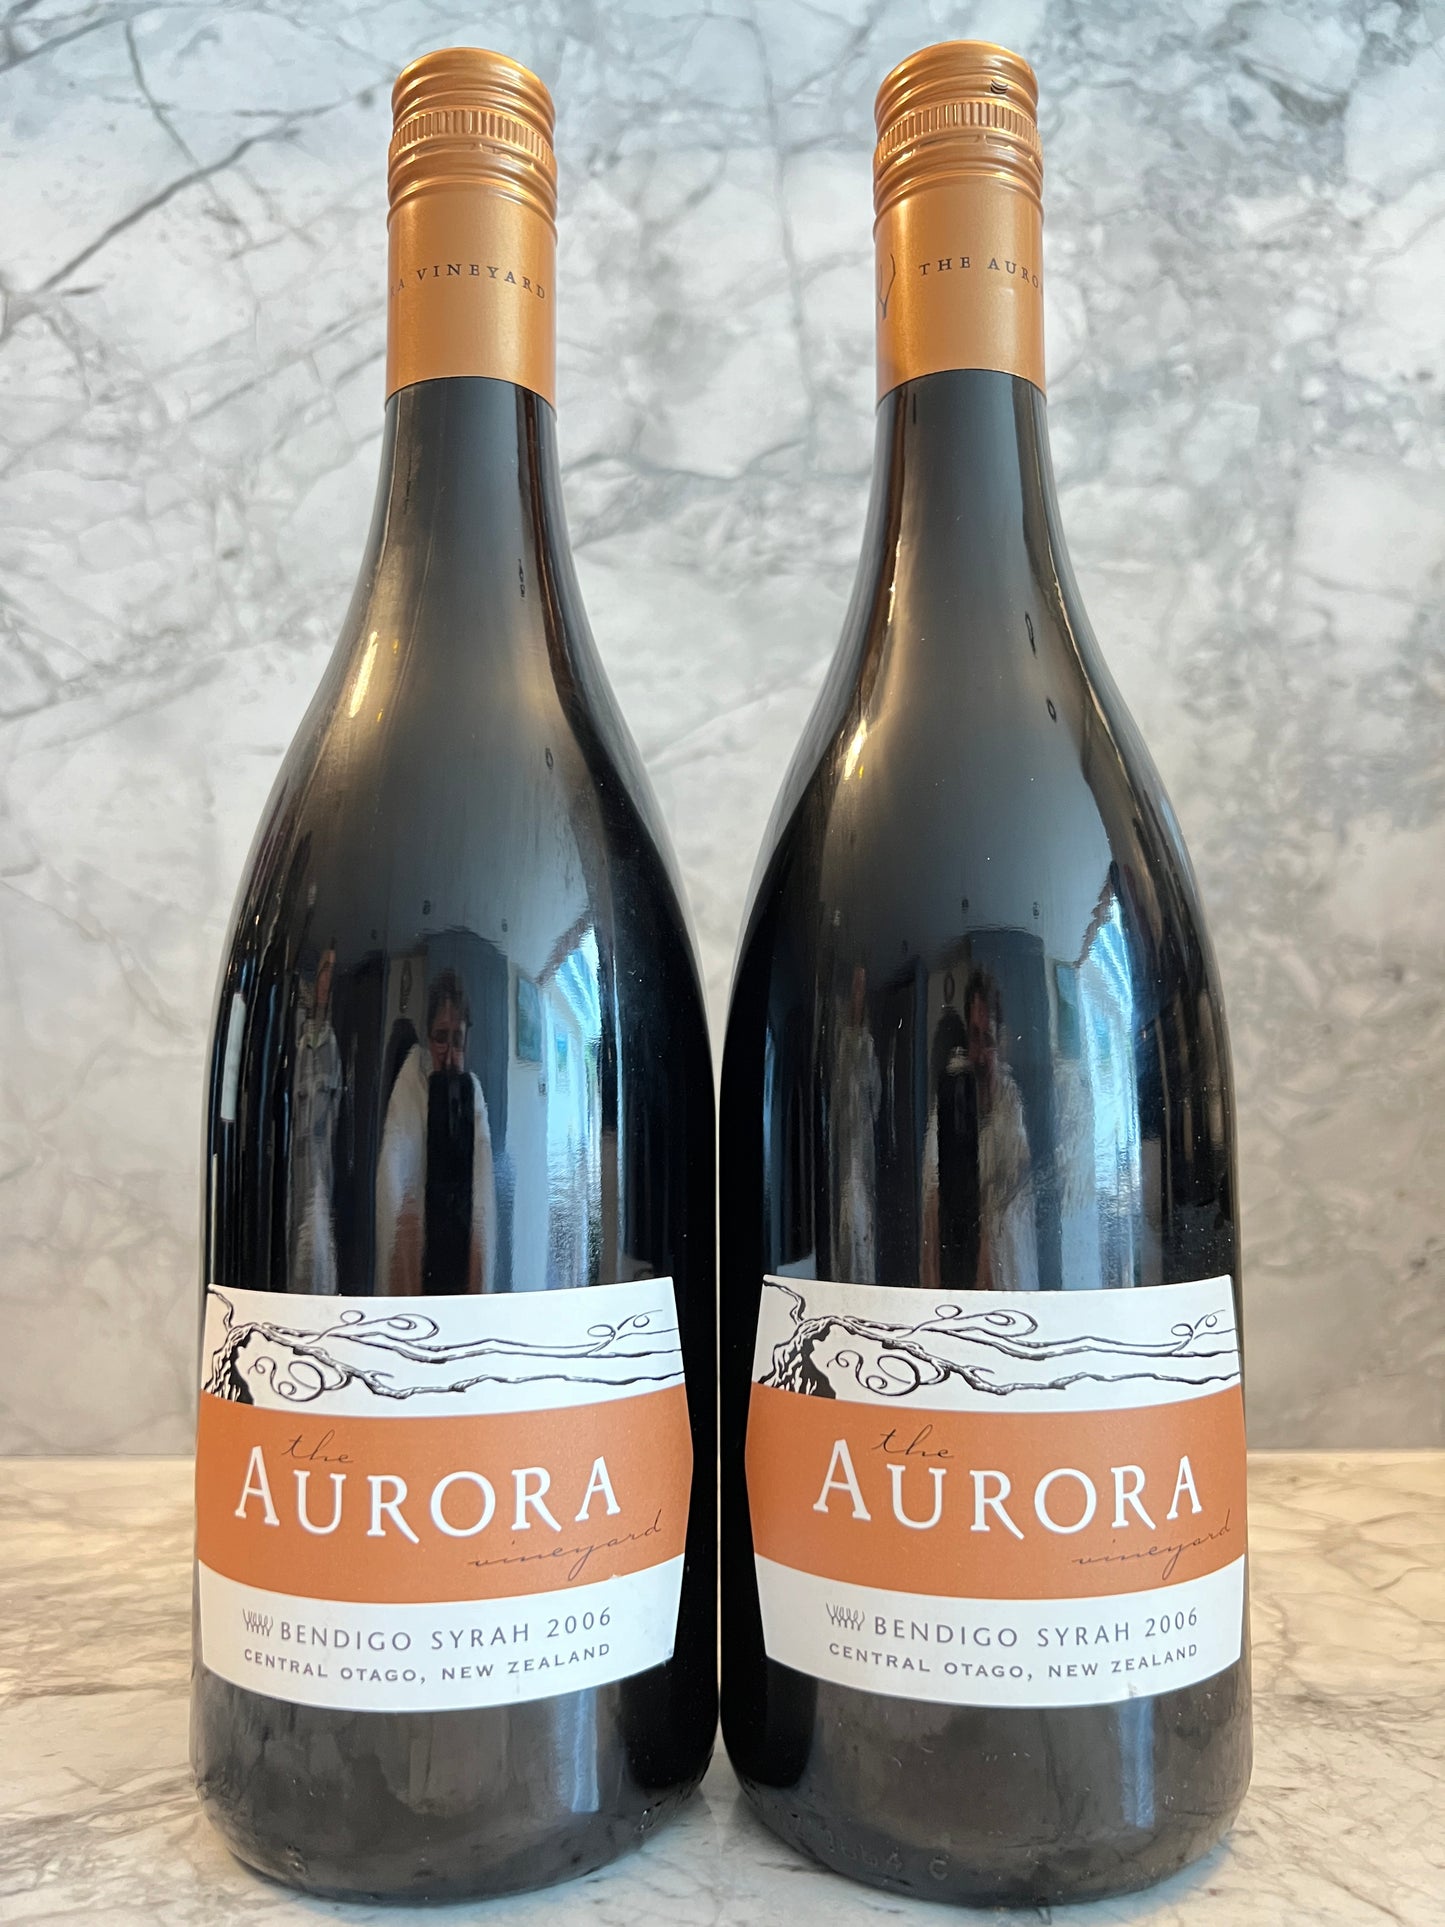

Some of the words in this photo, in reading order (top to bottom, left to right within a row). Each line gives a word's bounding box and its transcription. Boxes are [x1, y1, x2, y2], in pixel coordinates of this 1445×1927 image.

[416, 263, 545, 299] VINEYARD
[920, 257, 971, 276] THE
[987, 257, 1040, 289] AURO
[281, 1428, 355, 1464] the
[870, 1423, 955, 1459] the
[234, 1445, 621, 1544] AURORA
[812, 1438, 1204, 1540] AURORA
[467, 1508, 663, 1581] vineyard
[1071, 1508, 1232, 1580] vineyard
[280, 1621, 412, 1651] BENDIGO
[431, 1623, 529, 1650] SYRAH
[546, 1606, 612, 1638] 2006
[874, 1616, 1018, 1647] BENDIGO
[1037, 1621, 1130, 1647] SYRAH
[1144, 1606, 1198, 1638] 2006
[244, 1648, 329, 1678] CENTRAL
[340, 1667, 426, 1685] OTAGO,
[441, 1664, 494, 1681] NEW
[507, 1643, 611, 1674] ZEALAND
[828, 1642, 931, 1672] CENTRAL
[944, 1662, 1033, 1681] OTAGO,
[1048, 1662, 1099, 1678] NEW
[1111, 1644, 1198, 1674] ZEALAND
